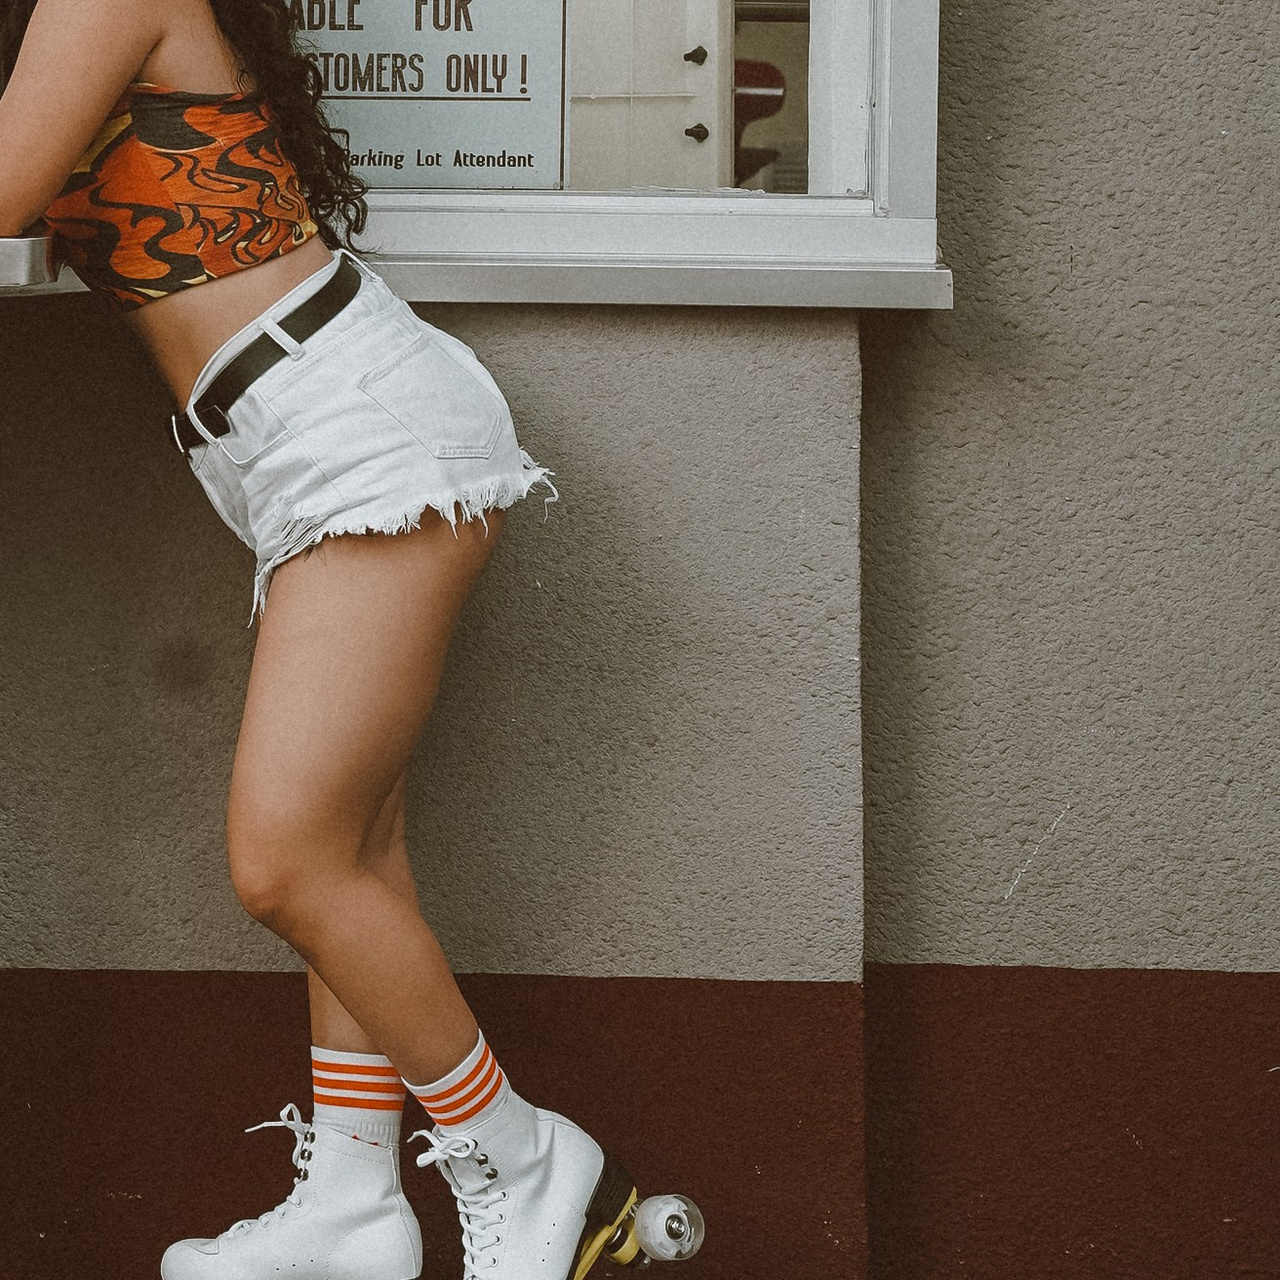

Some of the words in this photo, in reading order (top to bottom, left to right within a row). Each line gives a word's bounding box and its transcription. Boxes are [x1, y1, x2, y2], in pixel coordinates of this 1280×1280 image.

[304, 52, 424, 92] TOMERS
[344, 149, 405, 170] arking
[416, 149, 442, 167] Lot
[453, 149, 534, 168] Attendant
